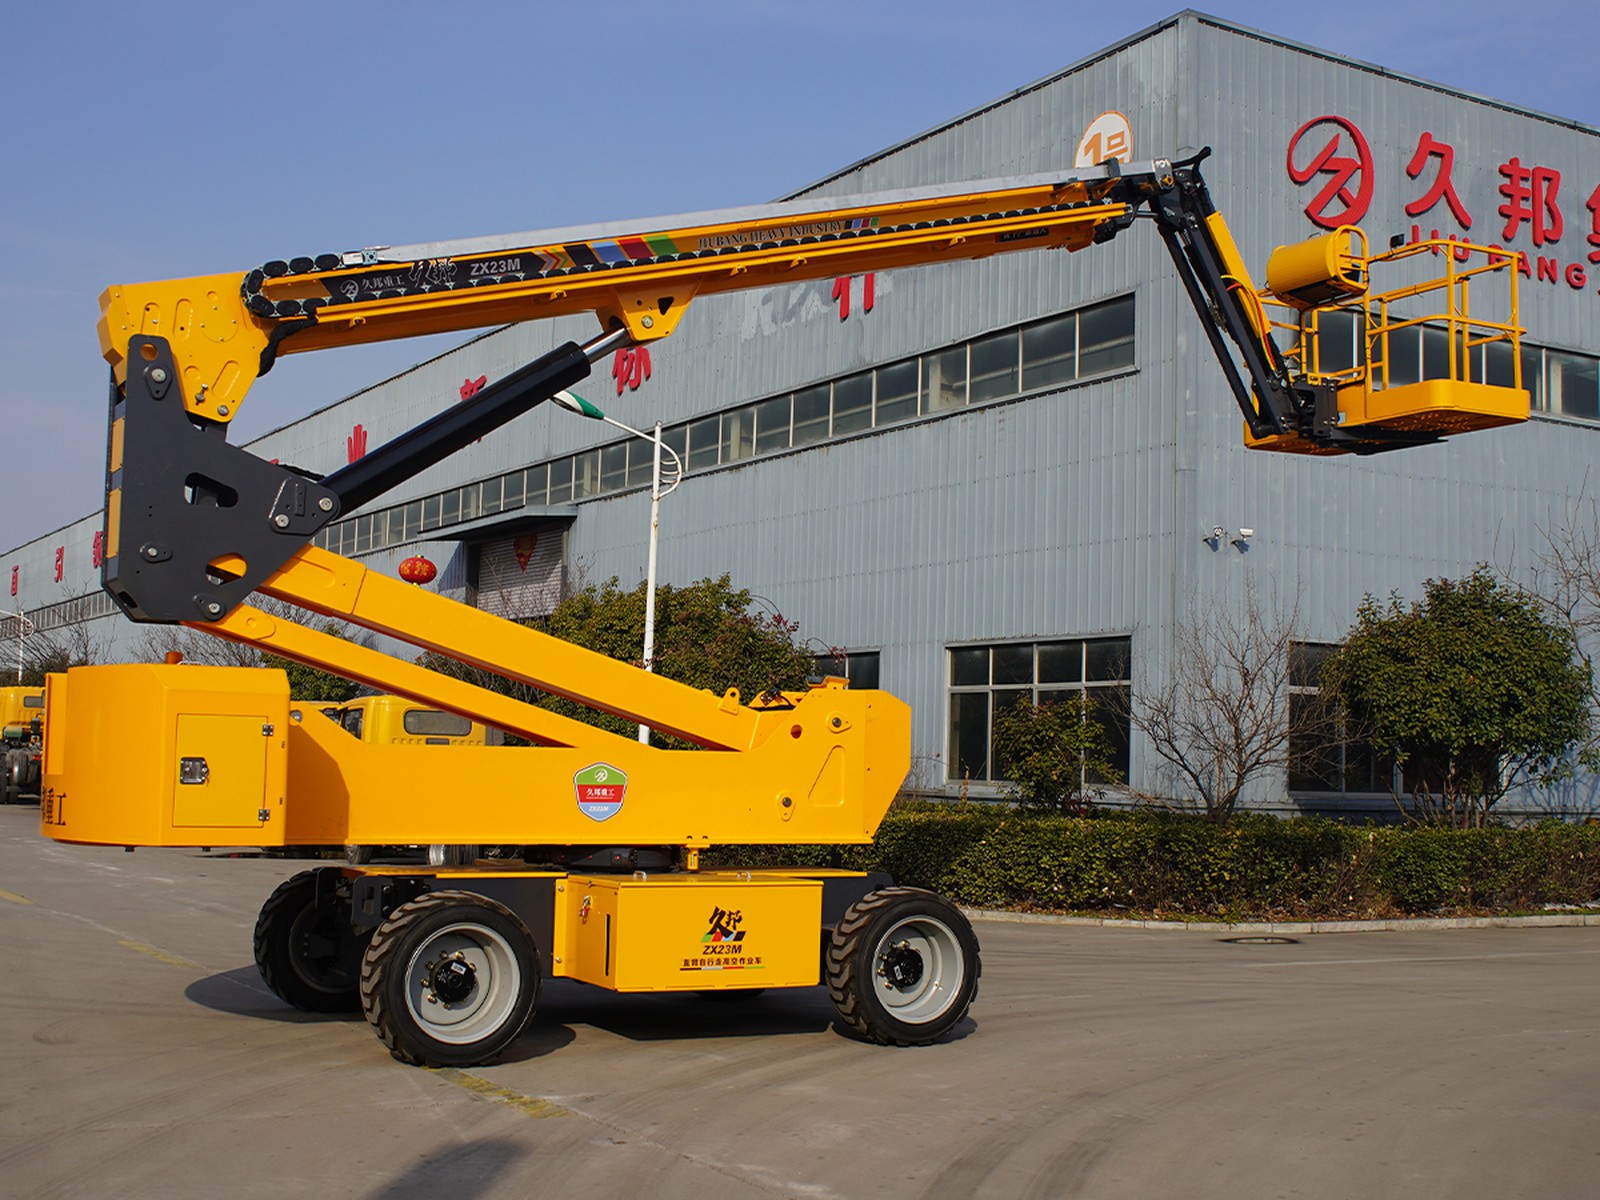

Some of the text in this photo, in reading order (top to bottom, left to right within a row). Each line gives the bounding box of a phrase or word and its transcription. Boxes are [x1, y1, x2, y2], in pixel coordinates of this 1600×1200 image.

[1405, 131, 1600, 265] 久邦
[750, 227, 787, 242] HEAVY
[788, 219, 843, 237] INDUSTRY
[470, 257, 521, 276] ZX23M
[706, 905, 743, 939] 久邦
[702, 944, 743, 955] ZX23M
